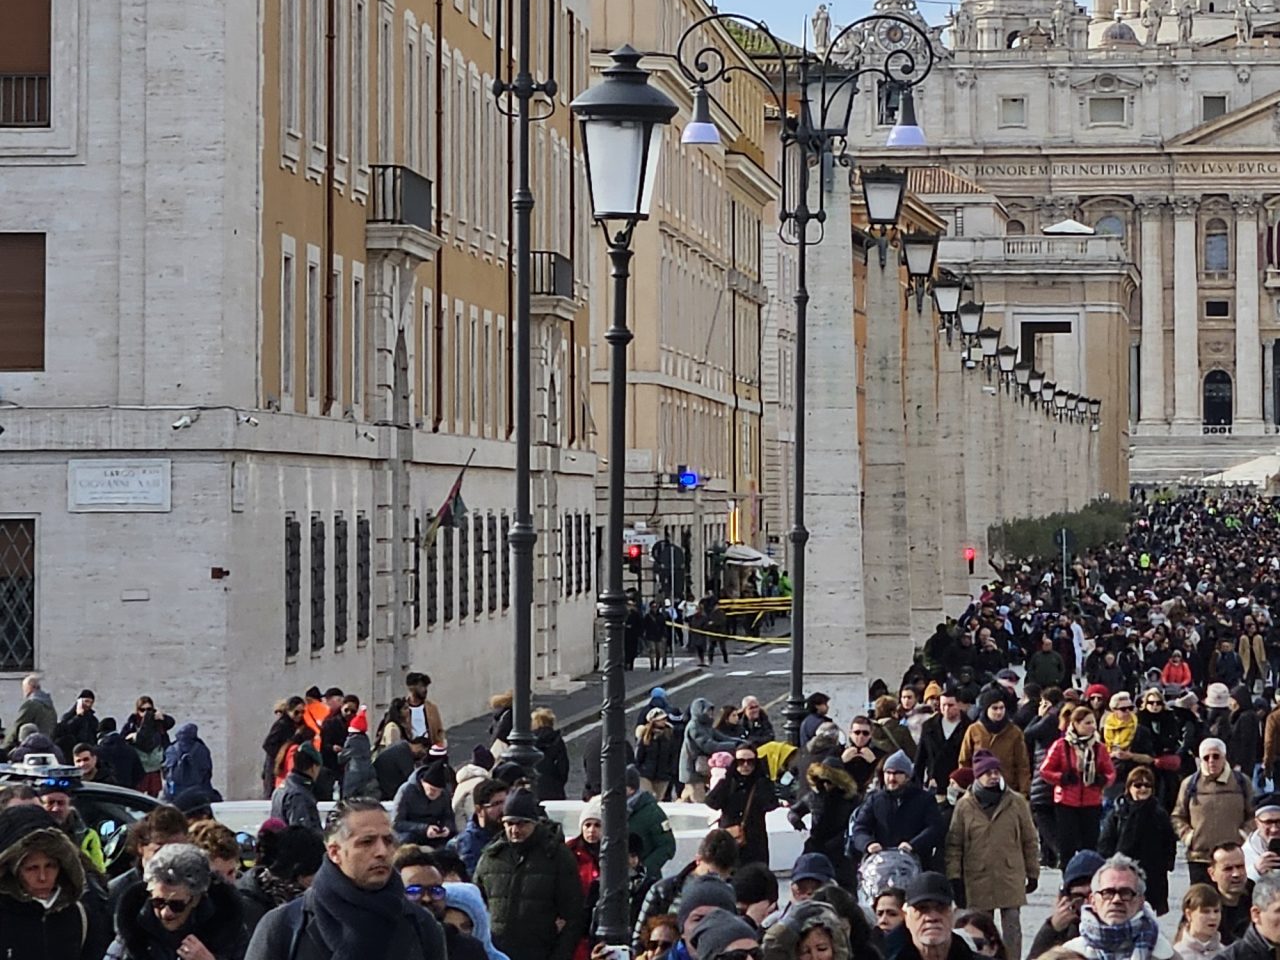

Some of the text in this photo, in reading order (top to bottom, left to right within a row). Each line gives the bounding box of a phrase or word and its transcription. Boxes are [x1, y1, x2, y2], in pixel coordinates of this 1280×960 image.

[975, 165, 1048, 176] HONOREM
[1053, 164, 1126, 175] PRINCIPIS
[1129, 163, 1171, 175] APOST
[1175, 162, 1224, 174] PAVLVS
[103, 469, 135, 478] LARGO
